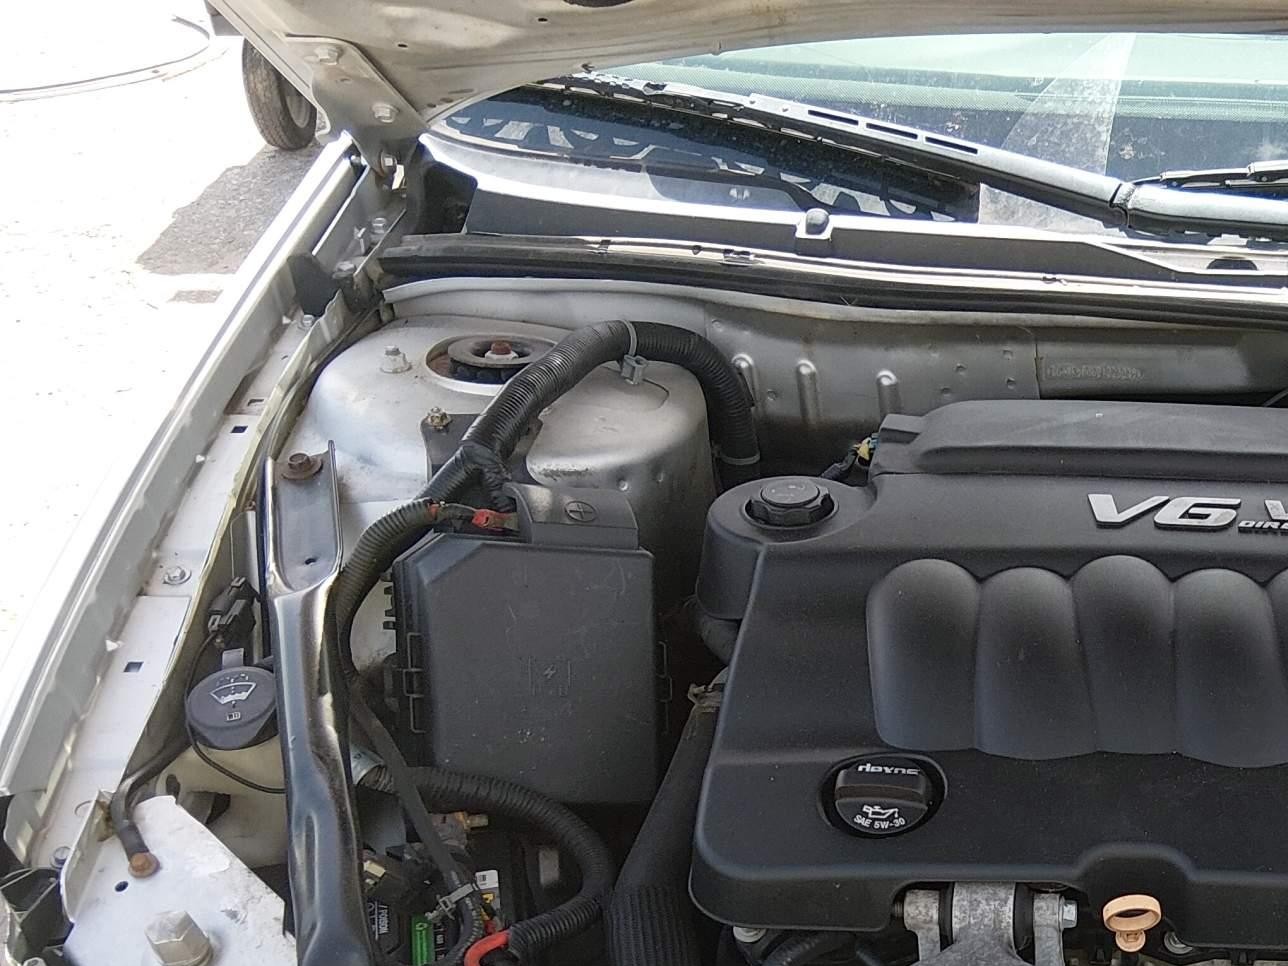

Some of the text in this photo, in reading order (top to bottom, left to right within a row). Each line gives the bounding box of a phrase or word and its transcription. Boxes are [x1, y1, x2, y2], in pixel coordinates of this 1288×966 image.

[1087, 493, 1242, 528] V6
[853, 814, 905, 829] SAE 5W-30
